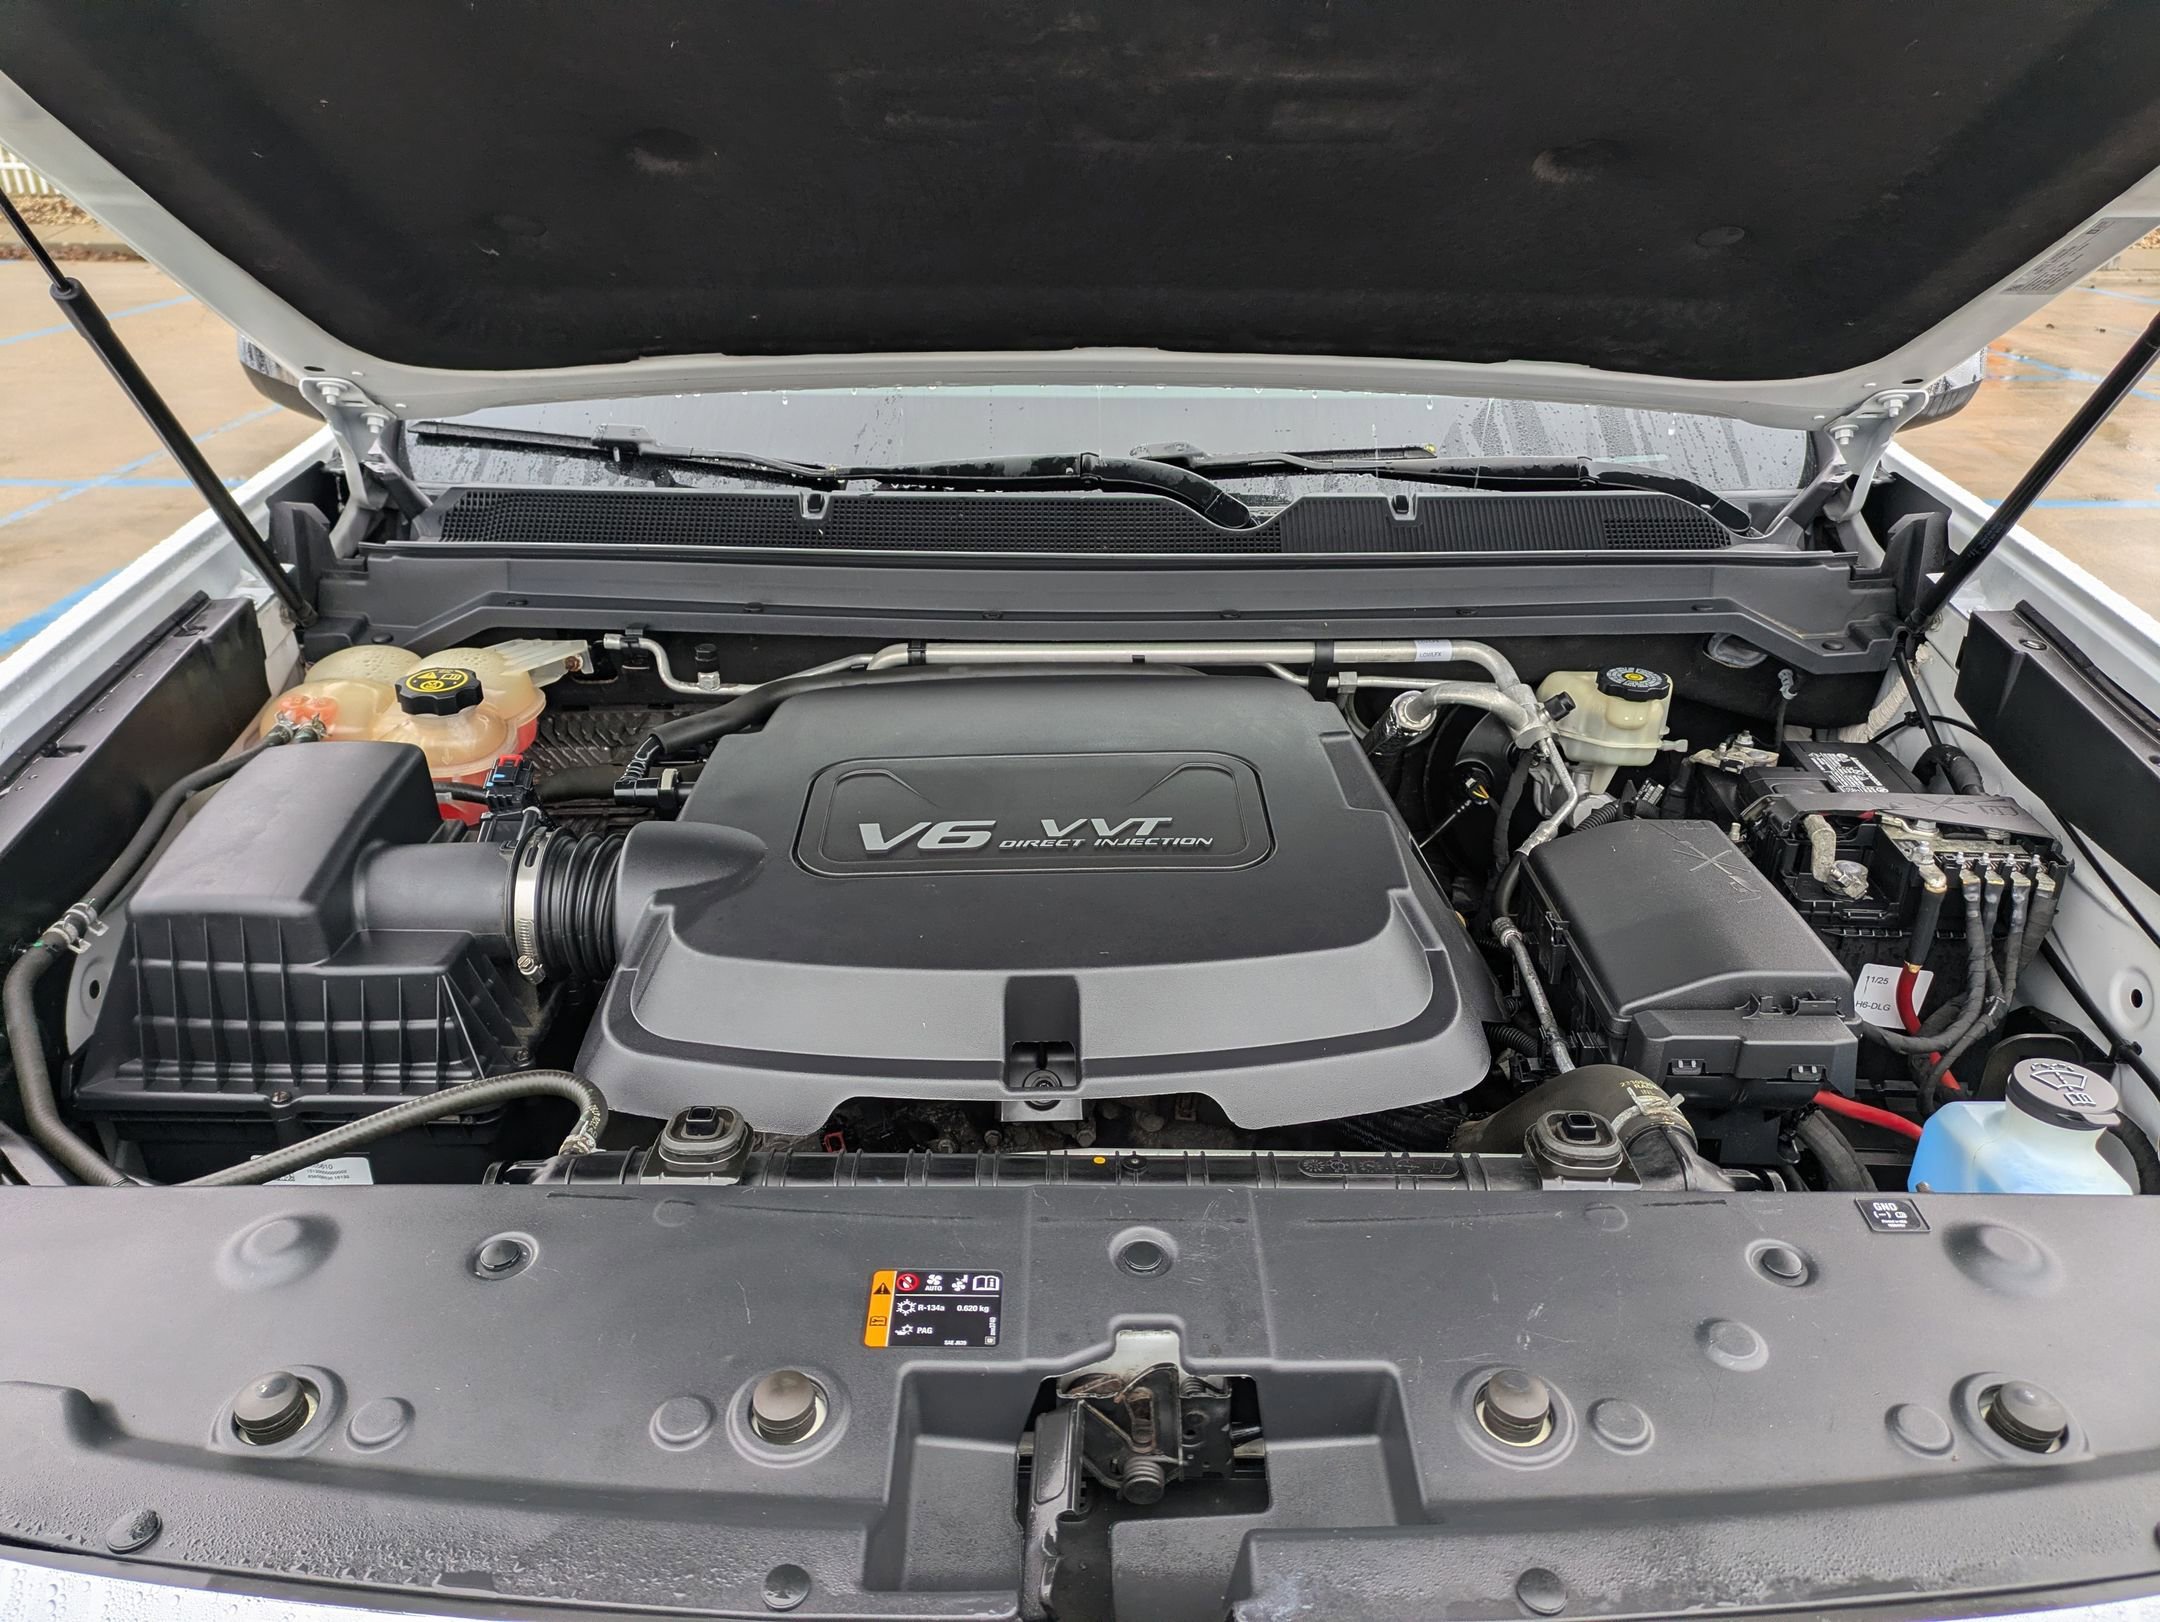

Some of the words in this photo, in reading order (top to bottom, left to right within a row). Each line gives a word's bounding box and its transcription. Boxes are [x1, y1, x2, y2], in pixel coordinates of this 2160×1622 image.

[859, 819, 996, 851] V6
[1041, 817, 1172, 837] VVT
[999, 838, 1086, 849] DIRECT
[1094, 837, 1213, 848] INJECTION
[1856, 1000, 1891, 1012] H6-DLG
[1873, 1202, 1898, 1211] GND
[917, 1304, 945, 1312] R-134a
[979, 1305, 990, 1313] kg
[916, 1327, 933, 1335] PAG
